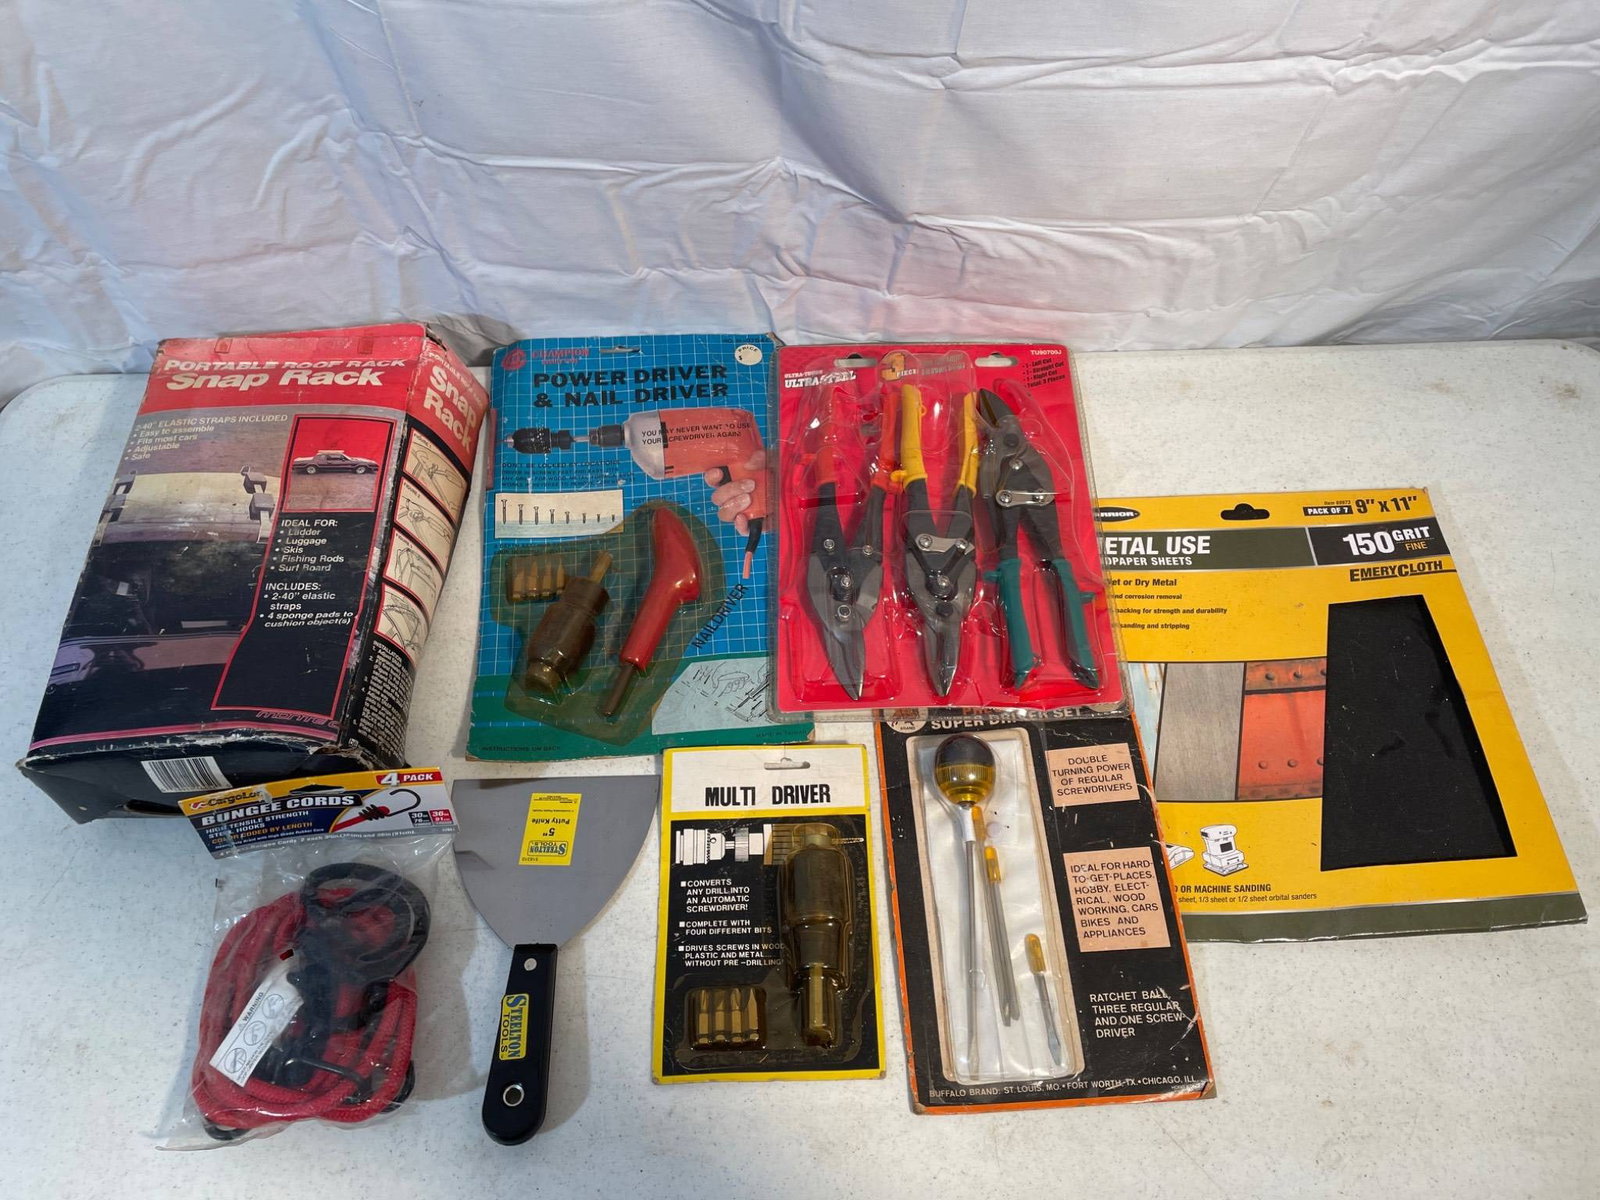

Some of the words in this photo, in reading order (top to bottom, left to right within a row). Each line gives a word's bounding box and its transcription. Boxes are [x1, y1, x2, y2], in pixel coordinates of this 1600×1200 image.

[164, 359, 279, 371] PORTABLE
[282, 360, 343, 369] ROOF
[347, 359, 406, 367] RACK
[166, 372, 270, 392] Snap
[279, 368, 385, 386] Rack
[534, 370, 626, 388] POWER
[634, 364, 728, 384] DRIVER
[430, 365, 477, 429] Snap
[534, 392, 553, 408] &
[565, 390, 623, 407] NAIL
[634, 384, 728, 403] DRIVER
[158, 417, 197, 428] ELASTIC
[200, 416, 236, 424] STRAPS
[238, 415, 288, 423] INCLUDED
[423, 387, 471, 454] Rack
[172, 426, 214, 434] assemble
[642, 437, 662, 445] YOUR
[134, 443, 180, 453] Adjustable
[131, 453, 151, 461] Safe
[1355, 499, 1375, 514] 9"
[1391, 496, 1418, 512] 11"
[286, 537, 327, 546] Luggage
[1166, 536, 1211, 555] USE
[1342, 531, 1395, 556] 150
[1392, 526, 1430, 541] GRIT
[1404, 541, 1427, 551] FINE
[283, 546, 303, 554] Skis
[281, 555, 316, 563] Fishing
[1151, 556, 1192, 566] SHEETS
[1350, 560, 1443, 582] EMERYCLOTH
[1135, 579, 1150, 588] Dry
[1152, 578, 1177, 586] Metal
[302, 592, 336, 600] elastic
[270, 603, 302, 611] straps
[275, 612, 313, 620] sponge
[315, 612, 340, 620] pads
[691, 584, 749, 649] NAILDRIVER
[265, 619, 305, 627] cushion
[1161, 622, 1190, 630] stripping
[932, 715, 984, 730] SUPER
[1053, 707, 1080, 718] SET
[1068, 755, 1107, 765] DOUBLE
[1052, 766, 1094, 777] TURNING
[1096, 763, 1131, 772] POWER
[381, 772, 400, 786] 4
[403, 773, 434, 782] PACK
[1061, 778, 1073, 786] OF
[1078, 774, 1123, 785] REGULAR
[705, 786, 756, 807] MULTI
[772, 783, 831, 805] DRIVER
[1057, 783, 1133, 796] SCREWDRIVERS
[202, 802, 281, 826] BUNGEE
[286, 795, 355, 809] CORDS
[230, 817, 263, 829] TENSILE
[265, 811, 309, 822] STRENGTH
[236, 823, 265, 833] HOOKS
[241, 828, 268, 839] CODED
[269, 826, 280, 834] BY
[282, 821, 313, 831] LENGTH
[530, 843, 566, 855] STEELTON
[1071, 864, 1099, 873] IDEAL
[1101, 862, 1120, 871] FOR
[1123, 860, 1154, 869] HARD-
[687, 879, 732, 887] CONVERTS
[1115, 882, 1150, 892] ELECT-
[1181, 885, 1192, 893] OR
[1194, 885, 1231, 893] MACHINE
[1234, 884, 1271, 892] SANDING
[706, 887, 729, 895] DRILL
[701, 895, 750, 904] AUTOMATIC
[1113, 892, 1145, 902] WOOD
[1178, 896, 1197, 904] sheet,
[686, 904, 748, 913] SCREWDRIVER!
[1132, 903, 1158, 912] CARS
[686, 920, 728, 928] COMPLETE
[1081, 917, 1111, 927] BIKES
[1117, 916, 1139, 924] AND
[709, 927, 752, 935] DIFFERENT
[1083, 927, 1146, 938] APPLIANCES
[685, 944, 713, 952] DRIVES
[1090, 991, 1136, 1003] RATCHET
[243, 992, 264, 1021] WARNING
[1092, 1004, 1128, 1014] THREE
[1131, 1001, 1180, 1012] REGULAR
[1095, 1017, 1117, 1026] AND
[1120, 1014, 1143, 1025] ONE
[506, 995, 527, 1058] STEELTON
[501, 1013, 510, 1052] TOOLS
[1096, 1027, 1135, 1038] DRIVER
[929, 1089, 966, 1098] BUFFALO
[1067, 1081, 1088, 1090] FORT
